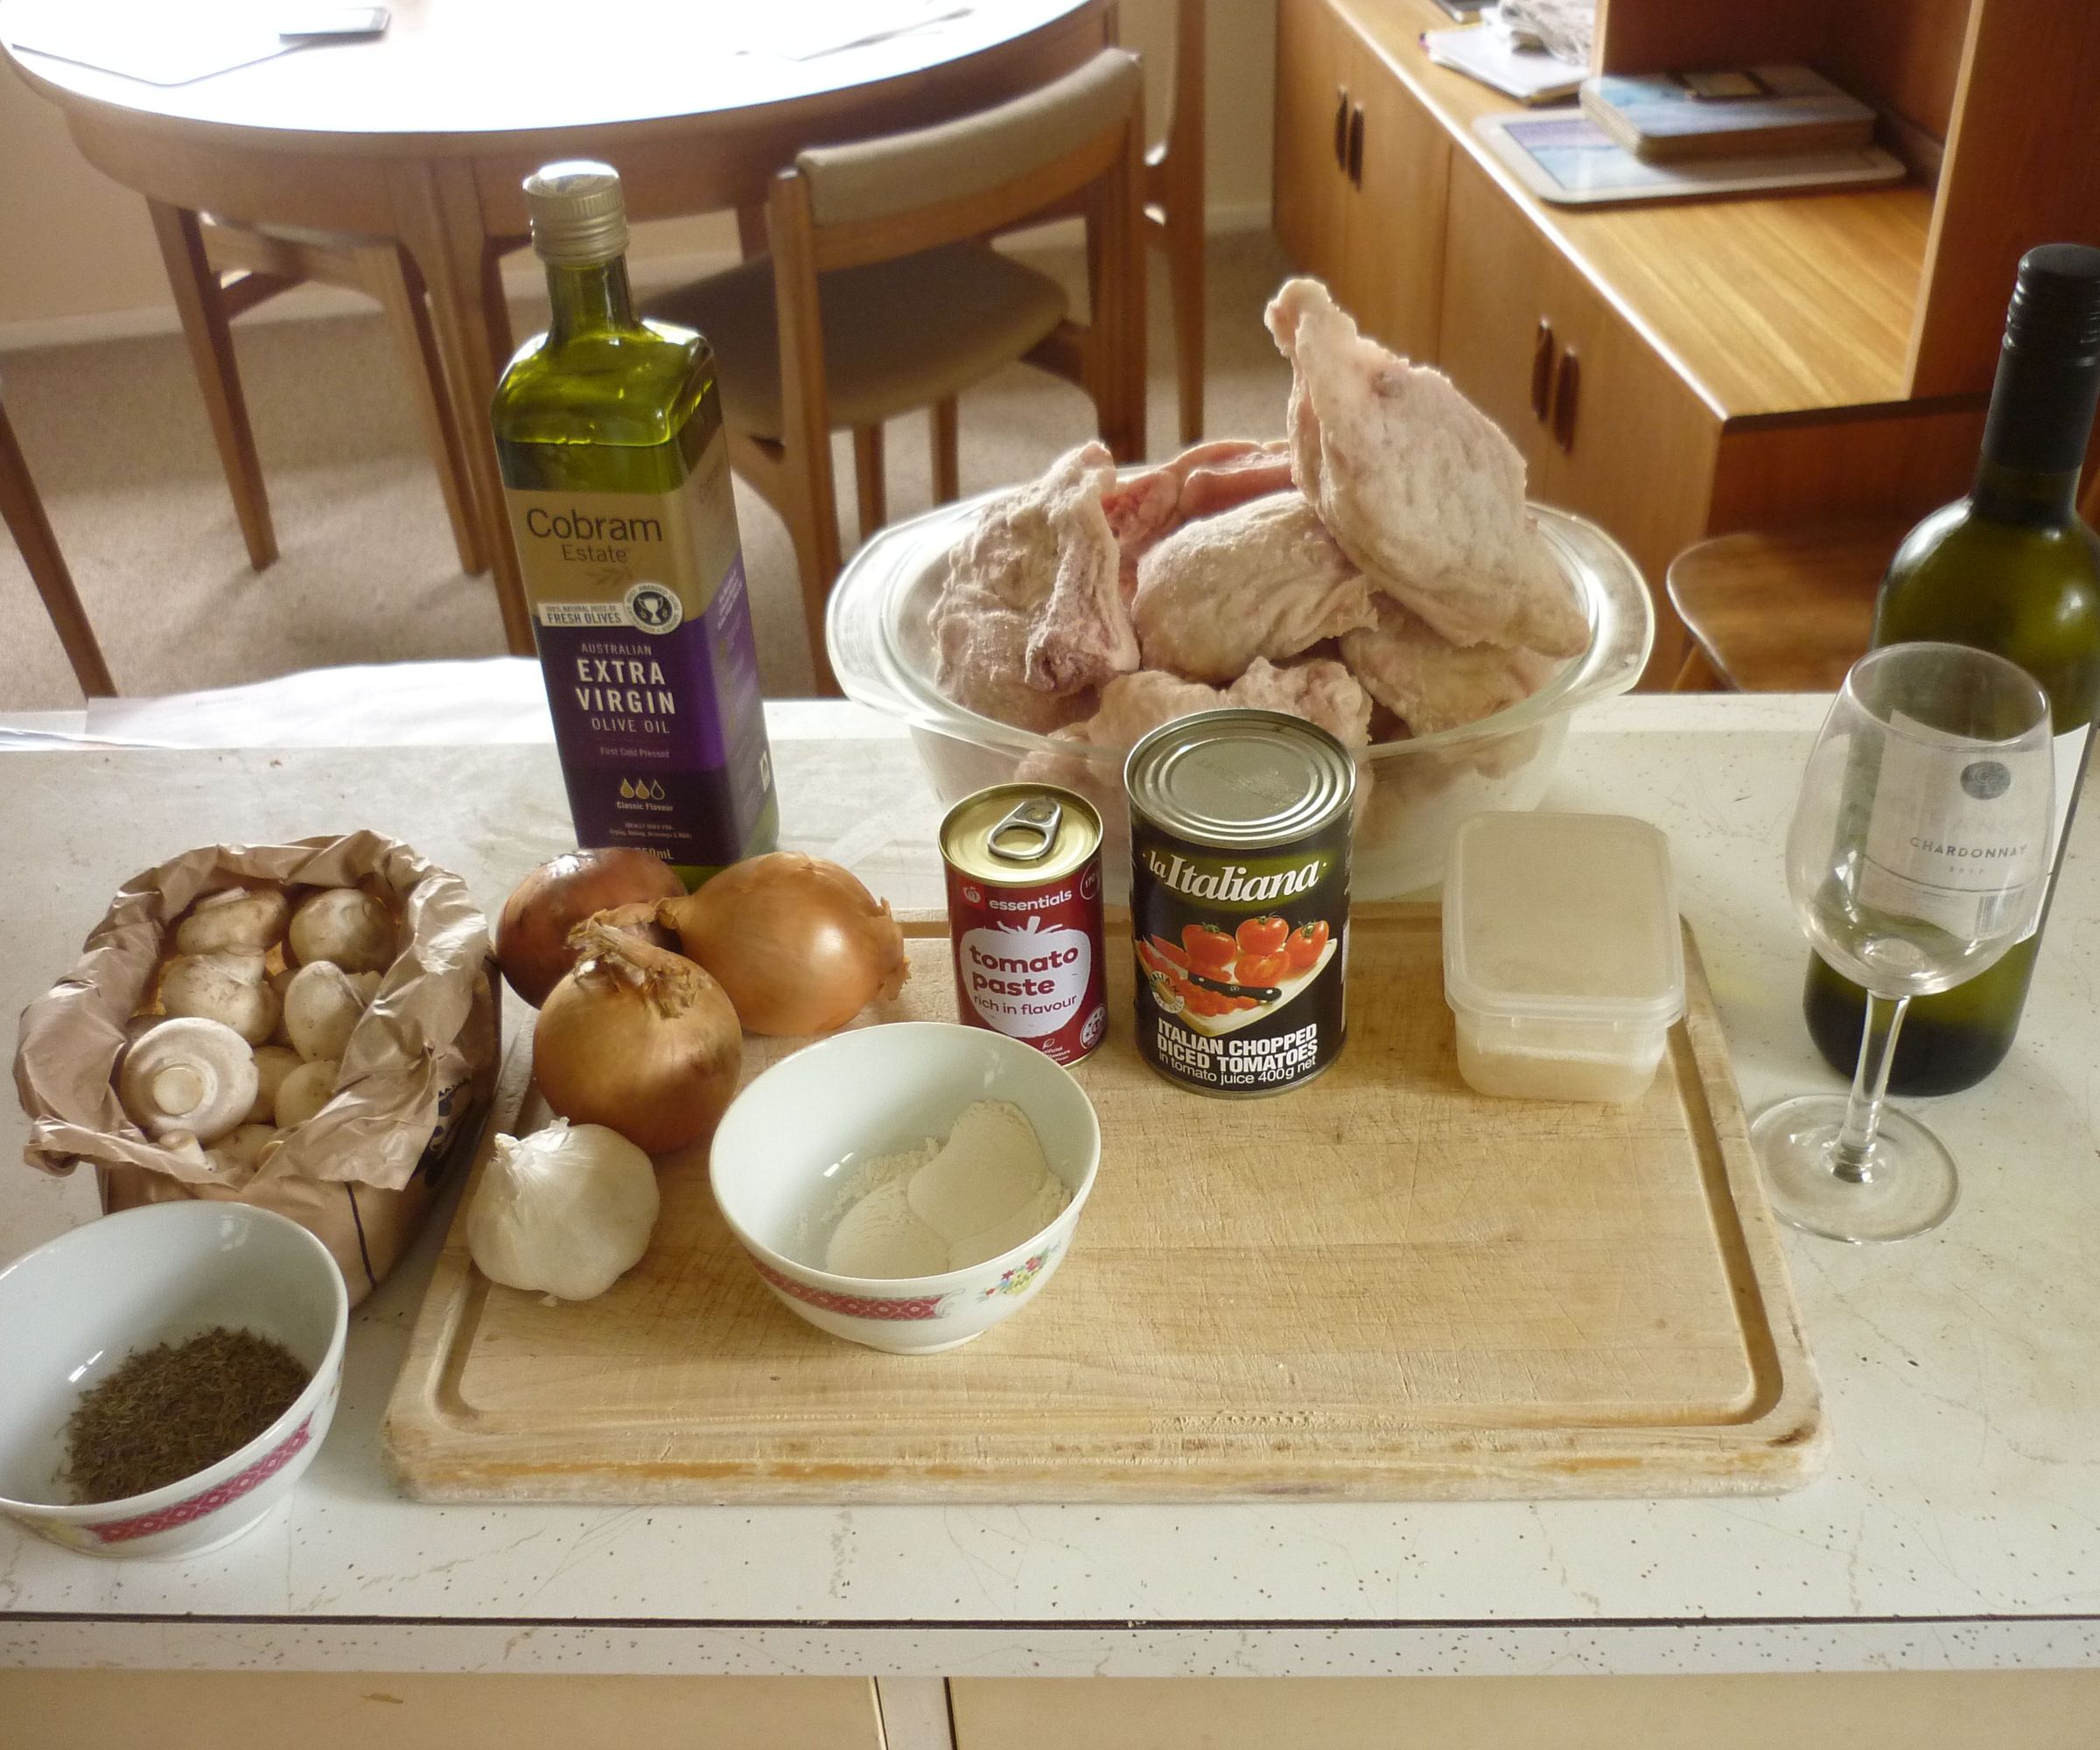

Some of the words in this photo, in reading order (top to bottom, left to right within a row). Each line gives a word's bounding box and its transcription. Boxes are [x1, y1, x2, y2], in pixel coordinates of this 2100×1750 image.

[527, 508, 663, 542] Cobram
[562, 543, 627, 563] Estate
[547, 613, 582, 624] FRESH
[584, 613, 622, 624] OLIVES
[581, 643, 652, 655] AUSTRALIAN
[577, 659, 666, 685] EXTRA
[575, 687, 676, 714] VIRGIN
[592, 718, 637, 732] OLIVE
[644, 720, 670, 734] OIL
[617, 801, 644, 810] Classic
[1910, 836, 2027, 858] CHARDONNAY
[1164, 854, 1320, 902] Italiana
[988, 890, 1073, 912] essentials
[970, 944, 1079, 974] tomato
[972, 971, 1056, 997] paste
[974, 995, 1000, 1012] rich
[1003, 1002, 1018, 1015] in
[1020, 994, 1078, 1016] flavour
[1158, 1017, 1223, 1055] ITALIAN
[1228, 1023, 1317, 1057] CHOPPED
[1157, 1033, 1210, 1069] DICED
[1216, 1039, 1319, 1074] TOMATOES
[1159, 1052, 1169, 1065] in
[1171, 1058, 1217, 1082] tomato
[1220, 1072, 1255, 1086] juice
[1257, 1067, 1295, 1083] 400g
[1297, 1055, 1317, 1074] net
